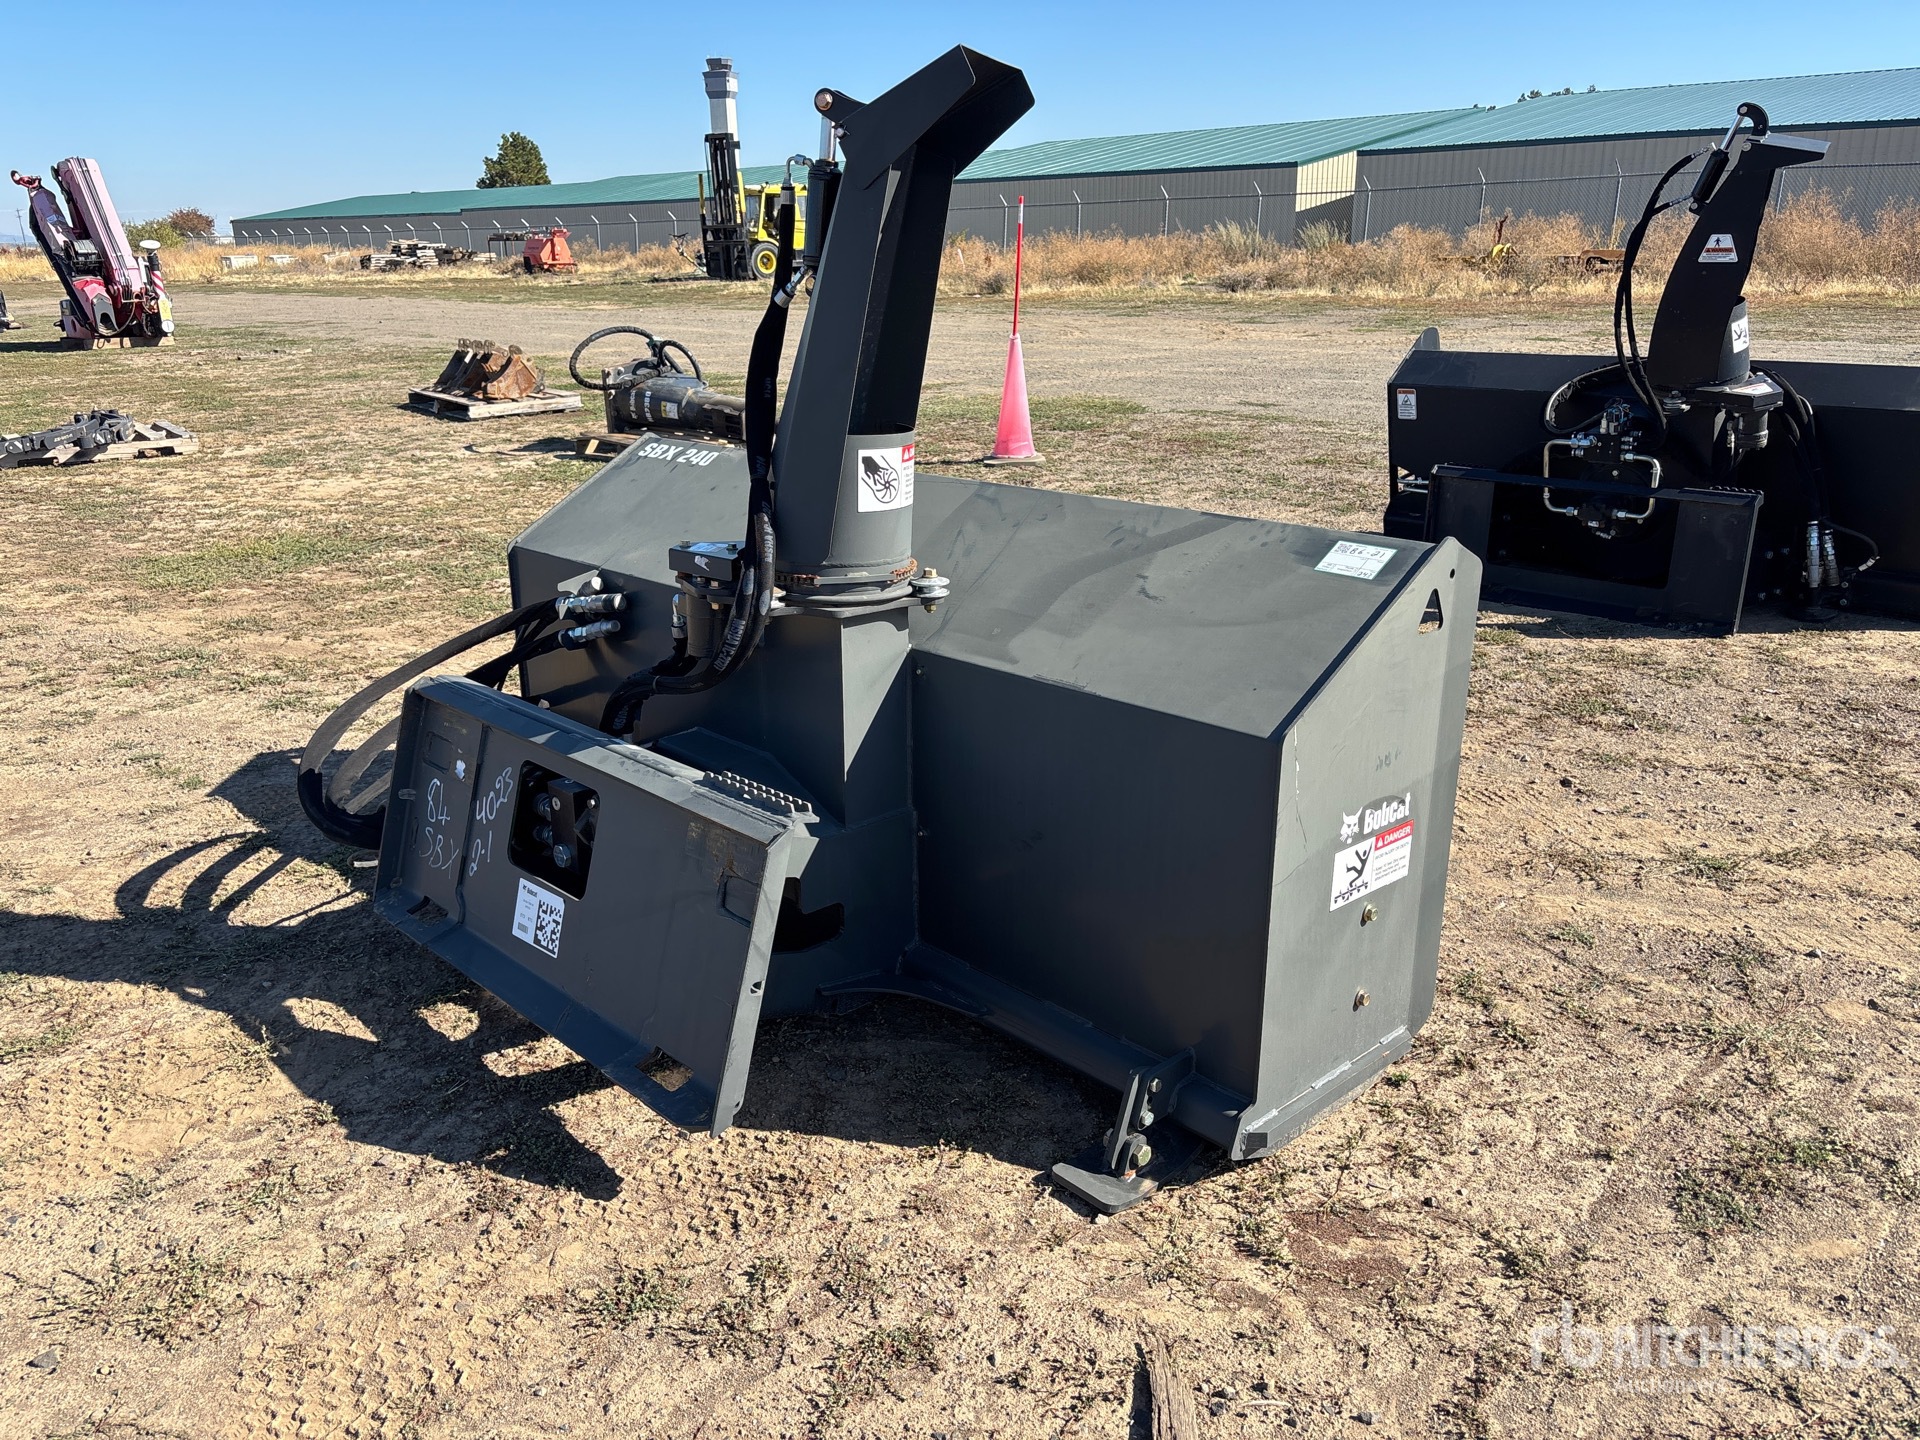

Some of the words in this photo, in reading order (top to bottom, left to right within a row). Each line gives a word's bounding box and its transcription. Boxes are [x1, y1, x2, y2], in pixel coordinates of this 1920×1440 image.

[638, 443, 684, 461] SBX
[676, 448, 720, 466] 240
[1363, 792, 1411, 835] Bobcat
[1384, 825, 1411, 845] DANGER
